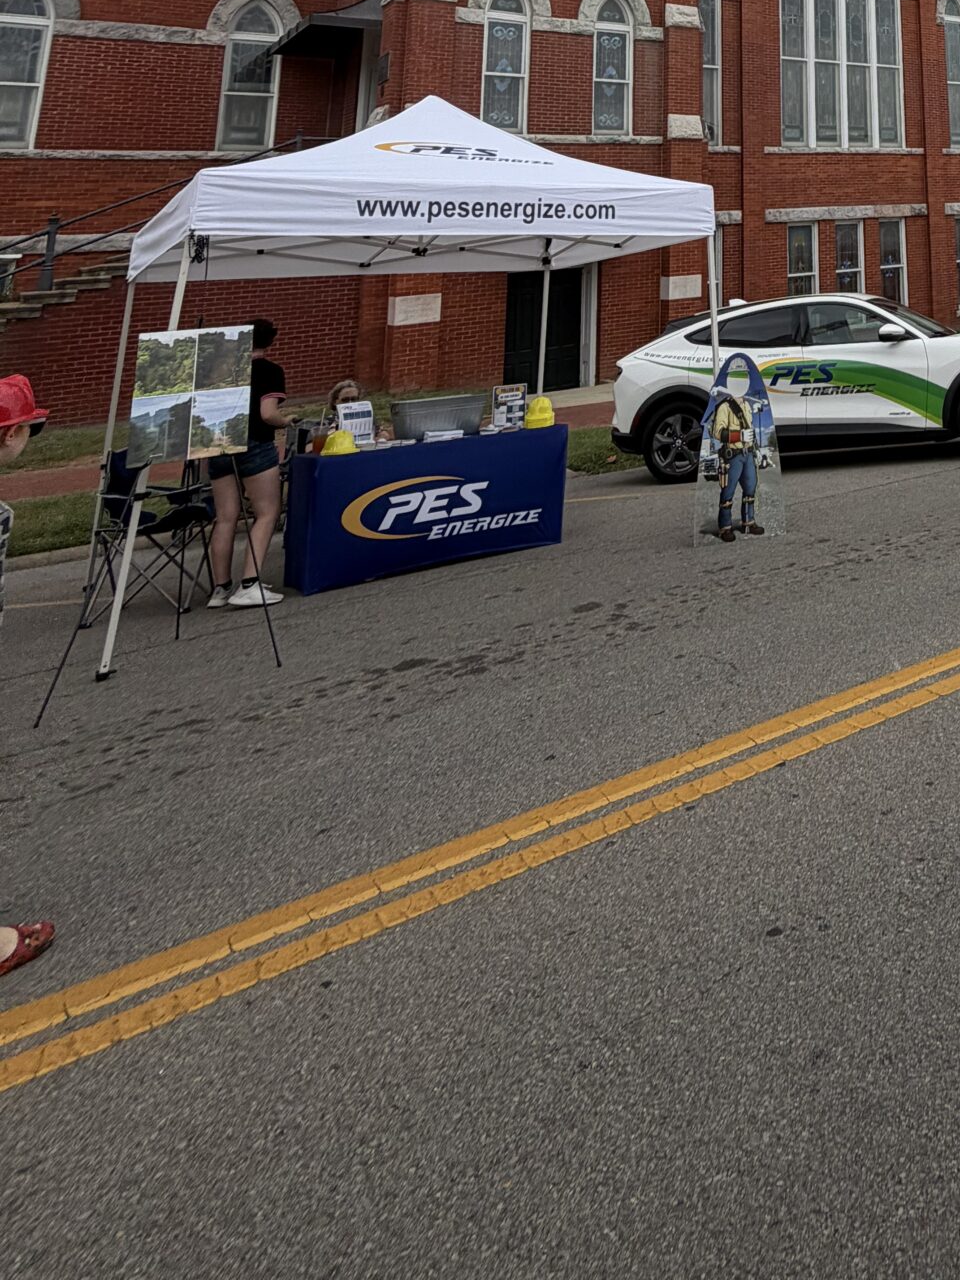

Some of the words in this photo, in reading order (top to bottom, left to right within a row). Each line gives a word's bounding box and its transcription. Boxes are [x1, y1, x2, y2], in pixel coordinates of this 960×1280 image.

[409, 145, 498, 157] PES
[457, 155, 554, 165] ENERGIZE
[357, 198, 616, 224] www.pesenergize.com
[770, 363, 837, 386] PES
[800, 383, 876, 397] ENERGIZE
[377, 481, 490, 531] PES
[427, 508, 543, 540] ENERGIZE
